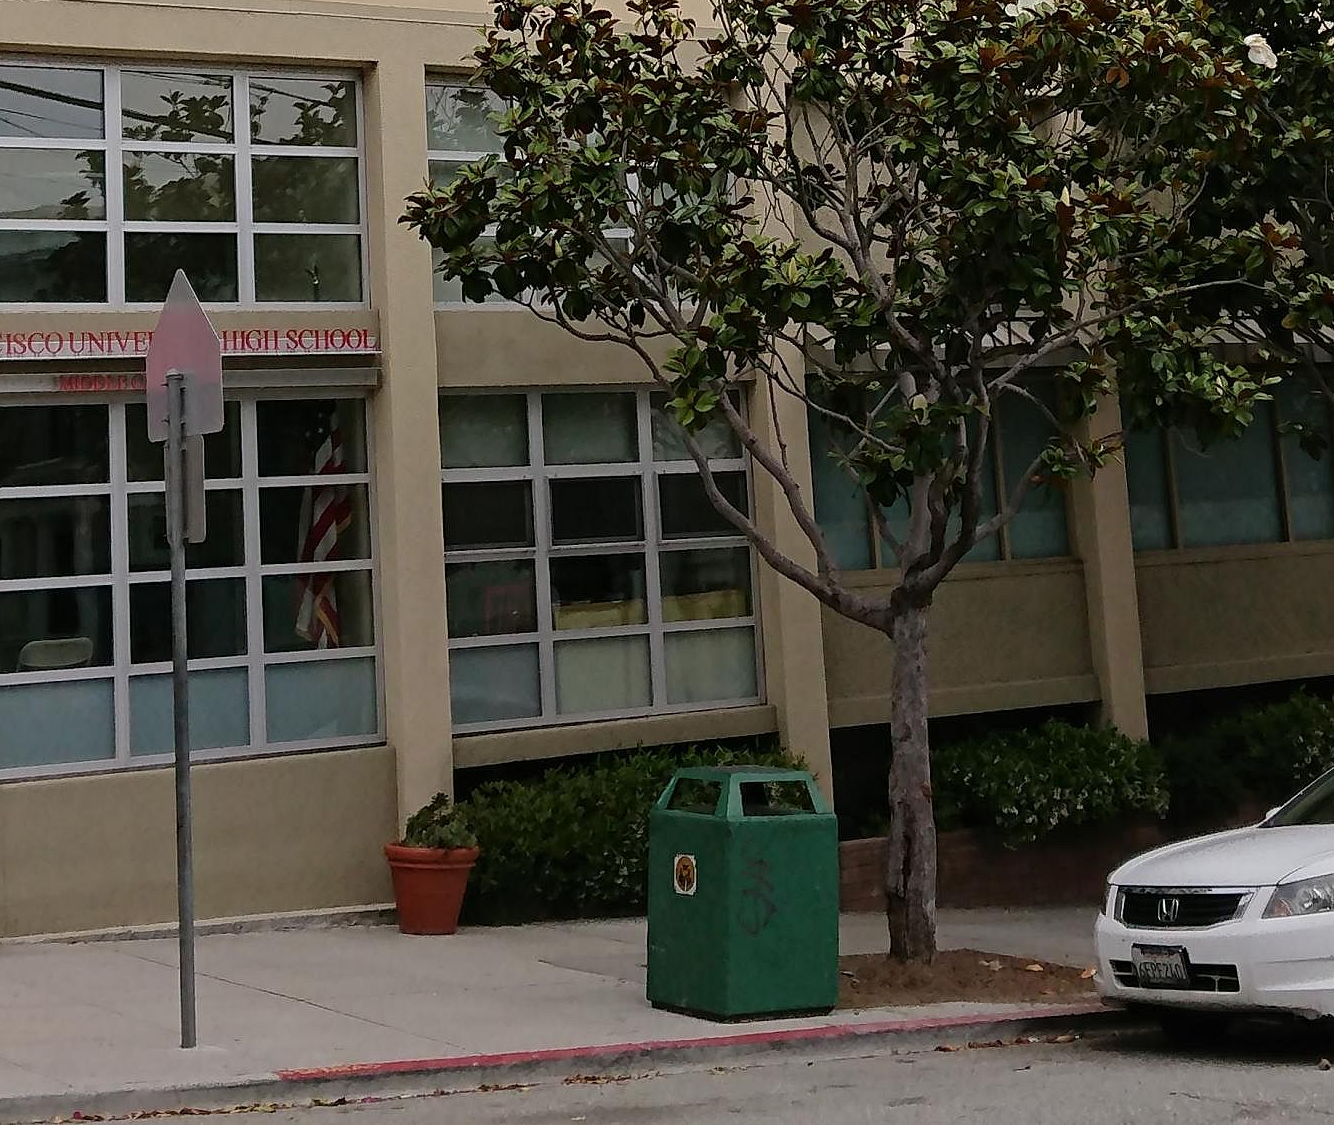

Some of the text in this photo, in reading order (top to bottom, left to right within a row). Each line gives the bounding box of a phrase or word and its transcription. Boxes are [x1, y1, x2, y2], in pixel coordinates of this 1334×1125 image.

[68, 330, 155, 353] UNIVE
[222, 329, 280, 352] HIGH
[285, 328, 377, 351] SCHOOL
